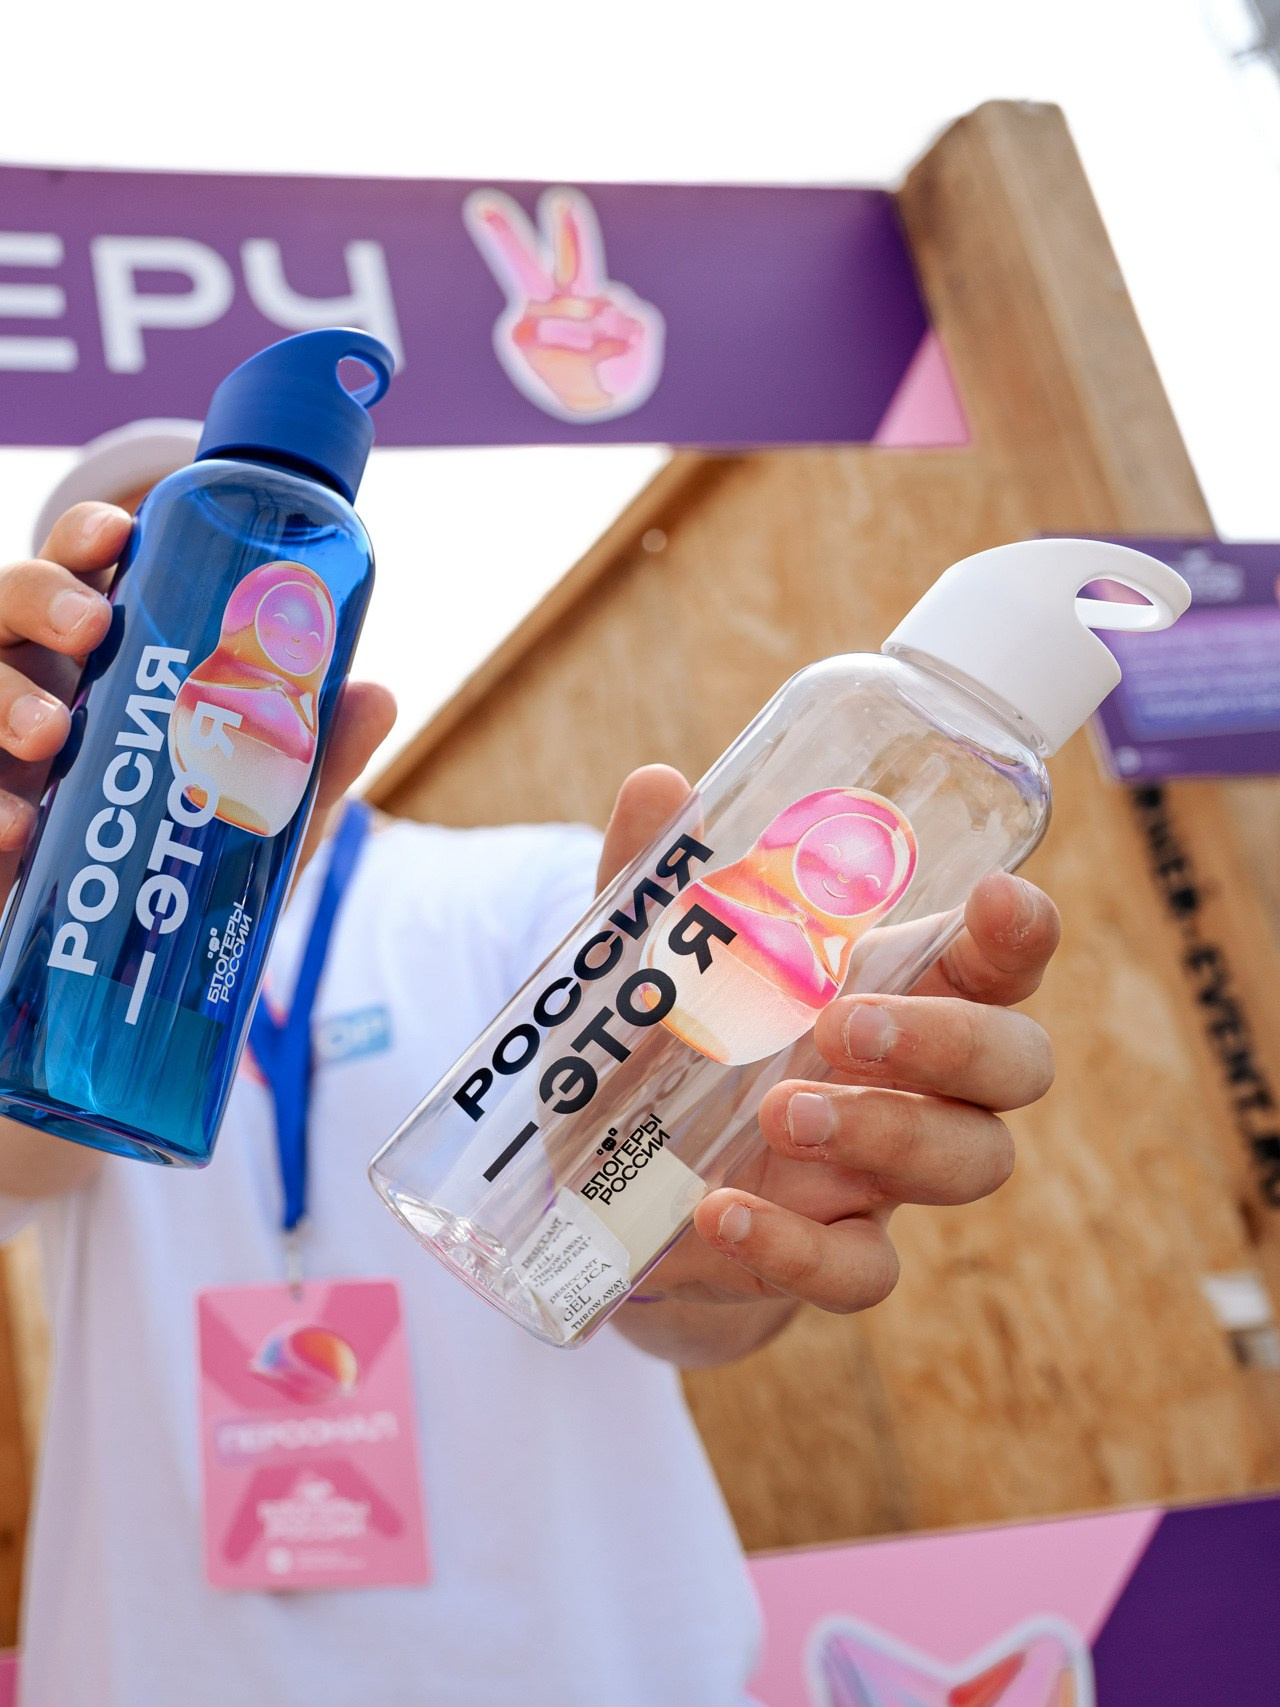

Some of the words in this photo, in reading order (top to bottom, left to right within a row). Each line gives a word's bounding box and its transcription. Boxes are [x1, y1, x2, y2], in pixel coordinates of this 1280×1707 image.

[47, 645, 190, 977] РОССИЯ
[136, 772, 218, 935] ЭТО
[189, 700, 243, 760] Я
[207, 901, 245, 1004] БЛОГЕРЫ
[220, 914, 253, 1003] РОССИИ
[453, 833, 715, 1122] РОССИЯ
[539, 968, 677, 1115] ЭТО
[668, 903, 738, 975] Я
[580, 1113, 663, 1200] БЛОГЕРЫ
[598, 1129, 671, 1206] РОССИИ
[554, 1257, 573, 1276] NOT
[563, 1263, 612, 1303] SILICA
[563, 1296, 592, 1322] GEL
[571, 1300, 602, 1330] THROW
[602, 1278, 624, 1302] AWAY
